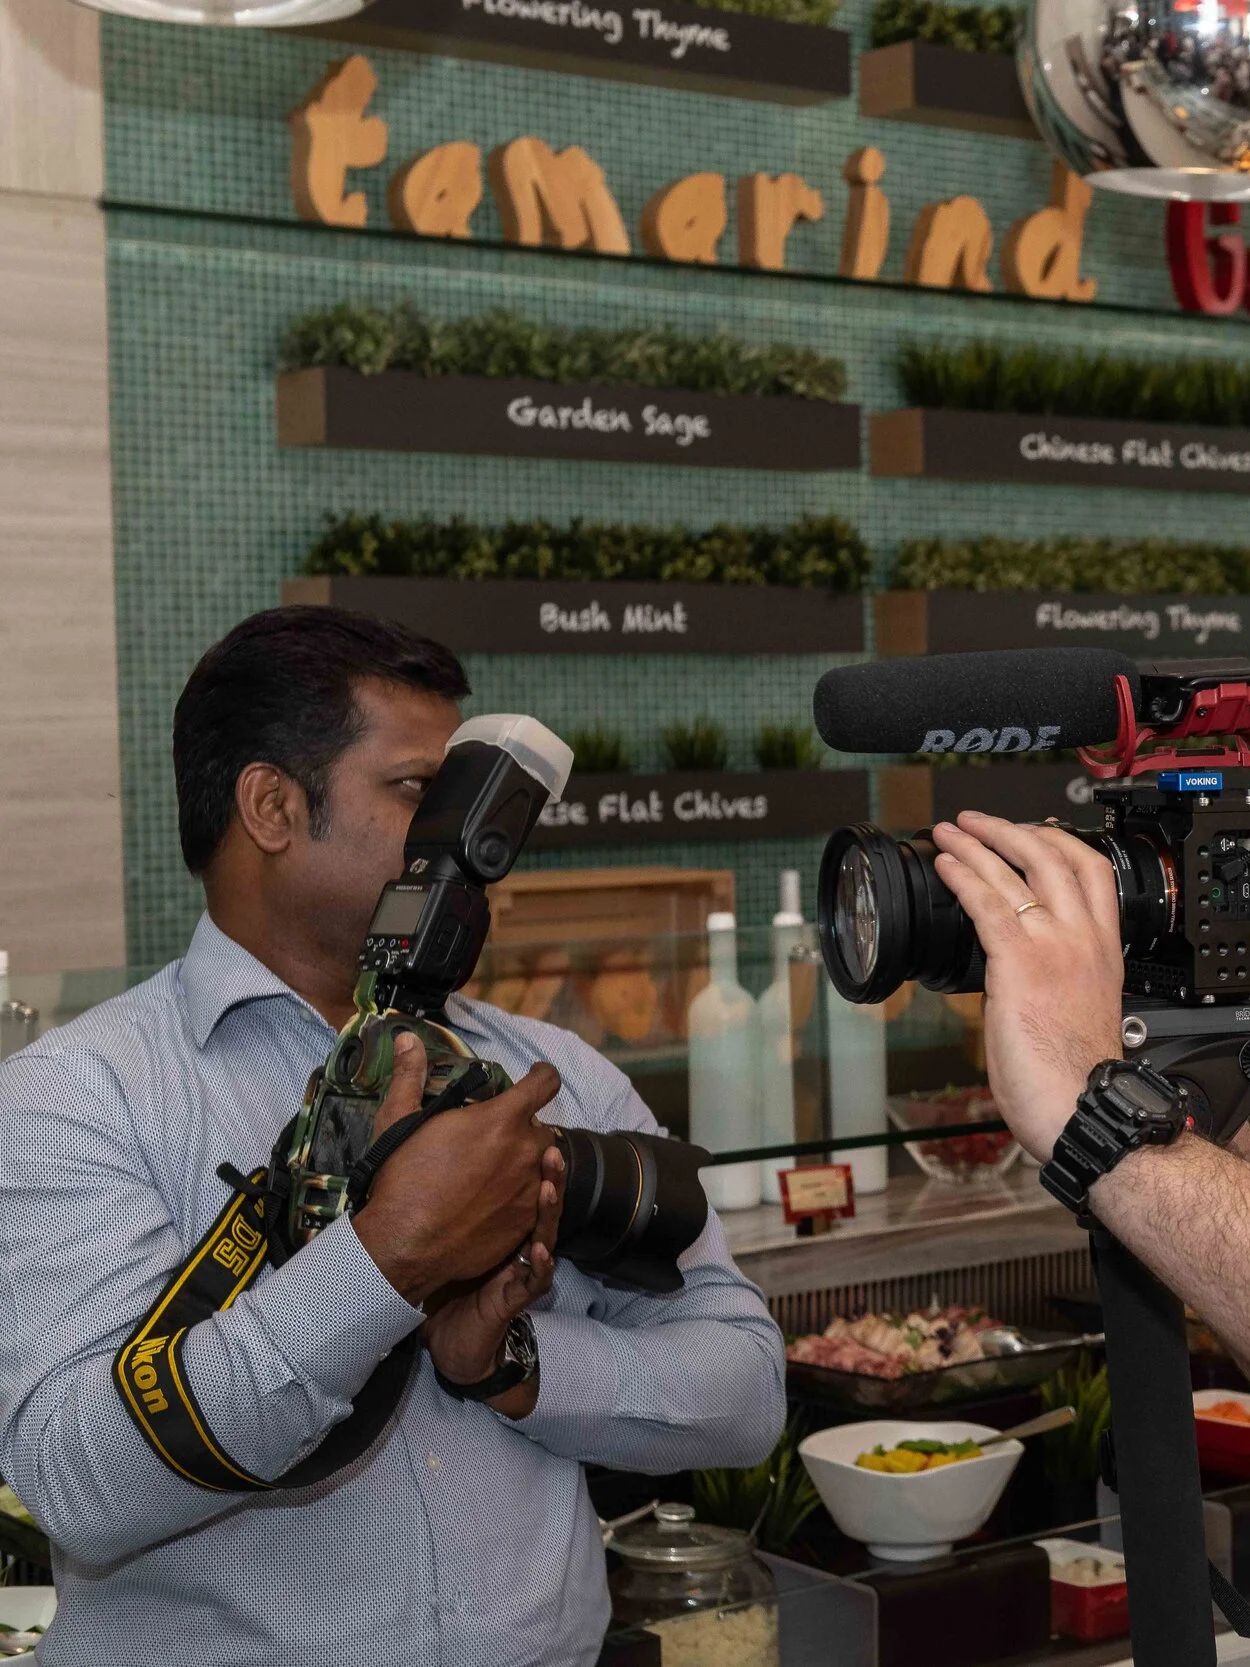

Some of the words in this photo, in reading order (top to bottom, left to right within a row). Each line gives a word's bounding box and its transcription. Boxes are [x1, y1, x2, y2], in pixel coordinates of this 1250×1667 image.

[632, 8, 731, 59] Thyme
[507, 395, 633, 433] Garden
[641, 404, 712, 447] Sage
[1019, 431, 1116, 465] Chinese
[1121, 438, 1174, 469] Flat
[540, 600, 612, 634] Bush
[622, 601, 688, 634] Mint
[1035, 601, 1160, 640] Flowering
[1165, 603, 1242, 645] Thyme
[1185, 777, 1218, 786] VOKING
[598, 790, 663, 823] Flat
[673, 790, 768, 822] Chives
[213, 1213, 262, 1277] D5
[131, 1335, 170, 1414] Nikon
